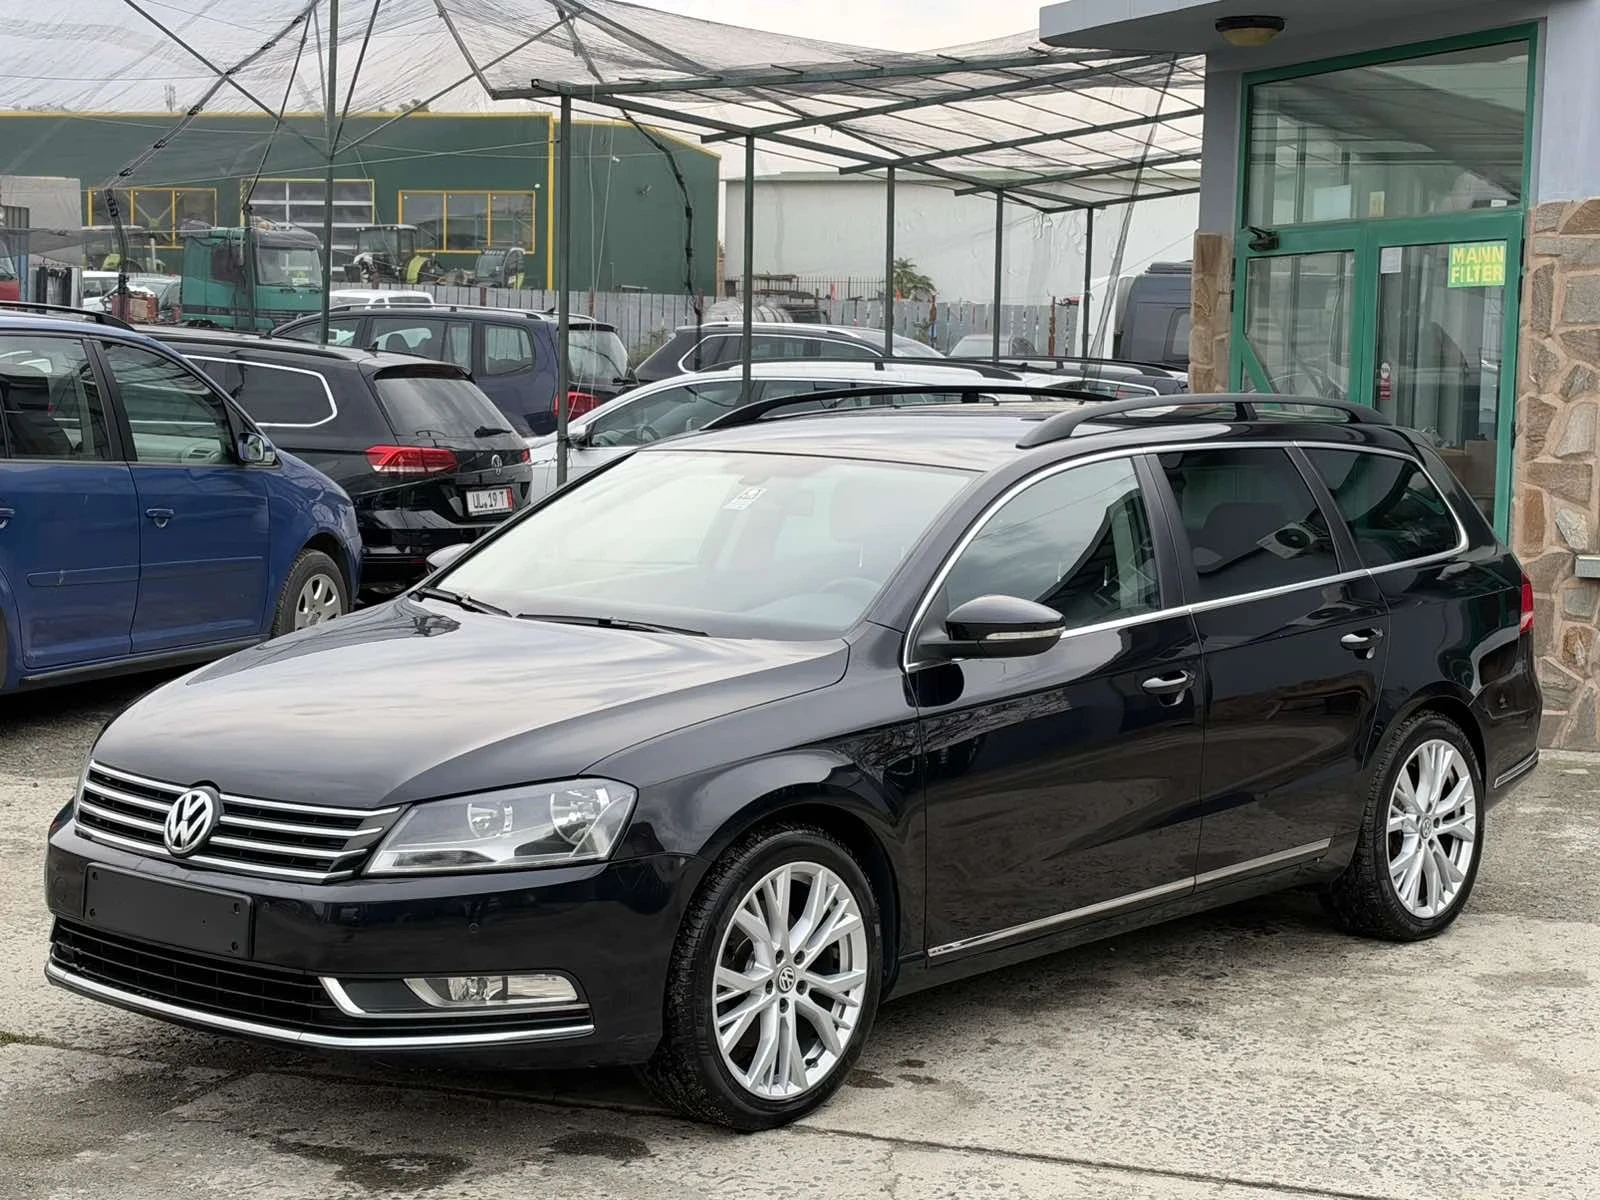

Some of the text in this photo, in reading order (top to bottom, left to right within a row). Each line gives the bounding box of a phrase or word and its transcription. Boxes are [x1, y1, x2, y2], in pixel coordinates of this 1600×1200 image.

[1451, 246, 1504, 264] MANN
[1451, 265, 1503, 283] FILTER
[488, 491, 498, 507] 19
[164, 789, 213, 854] VW
